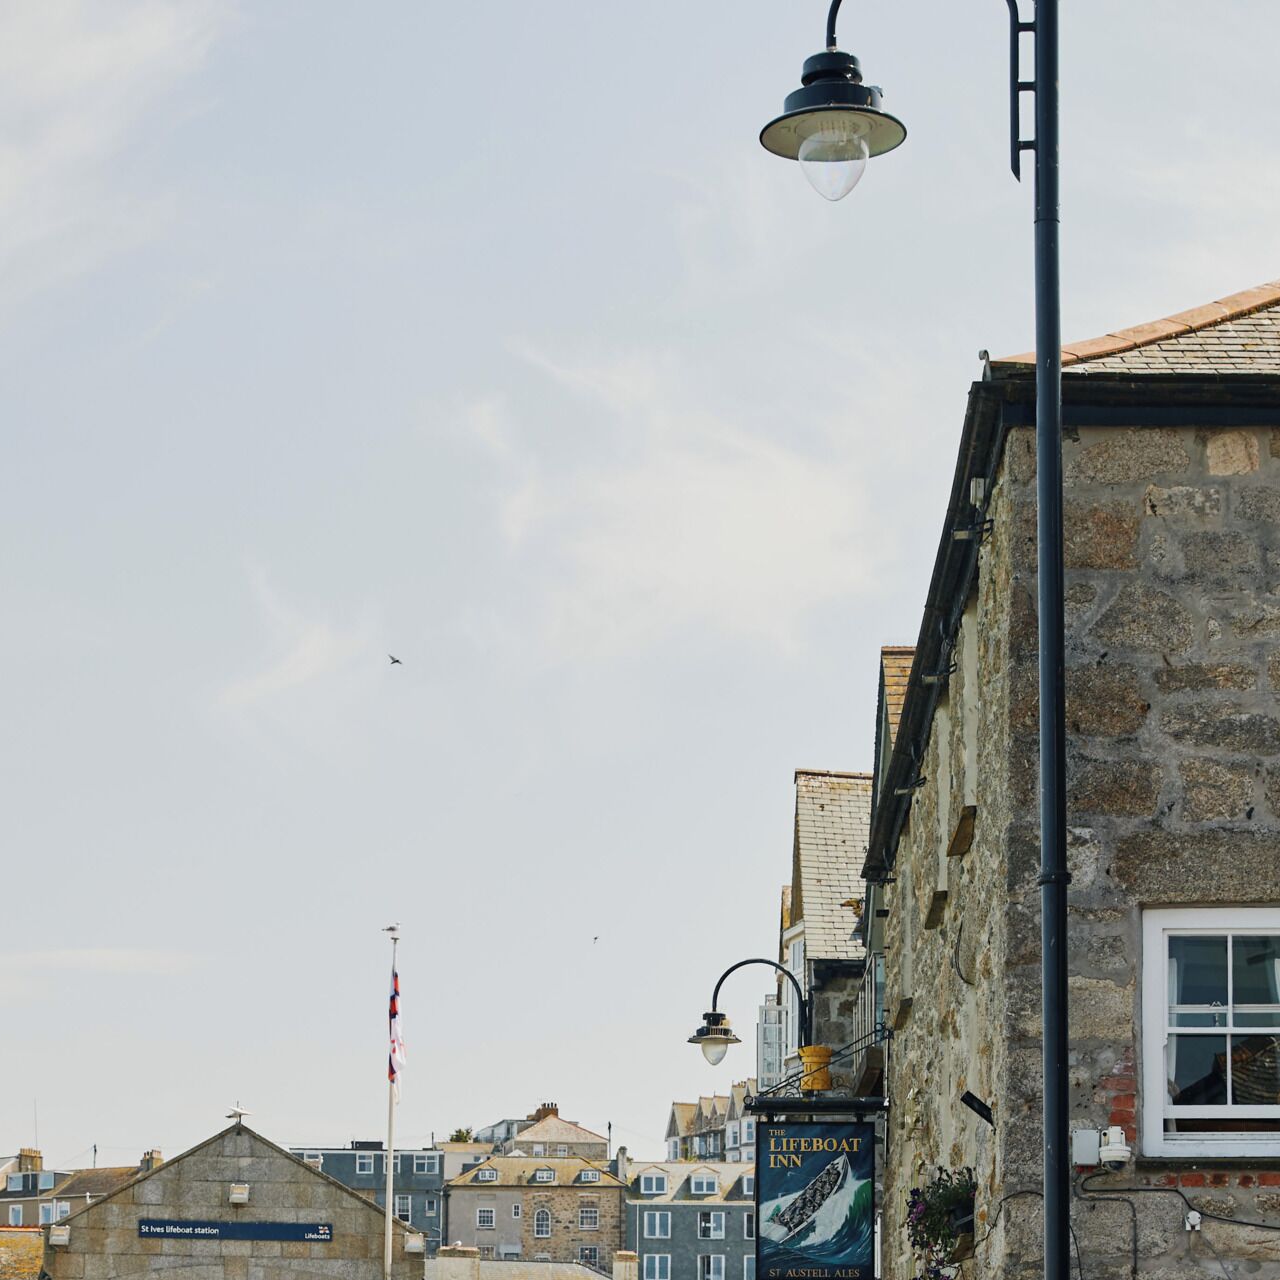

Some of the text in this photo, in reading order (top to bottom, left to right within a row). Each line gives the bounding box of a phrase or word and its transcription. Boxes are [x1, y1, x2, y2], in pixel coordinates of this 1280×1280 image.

[768, 1138, 862, 1152] LIFEBOAT
[768, 1154, 802, 1168] INN
[140, 1225, 220, 1235] St Ives lifeboat station
[769, 1268, 860, 1278] ST AUSTELL ALES
